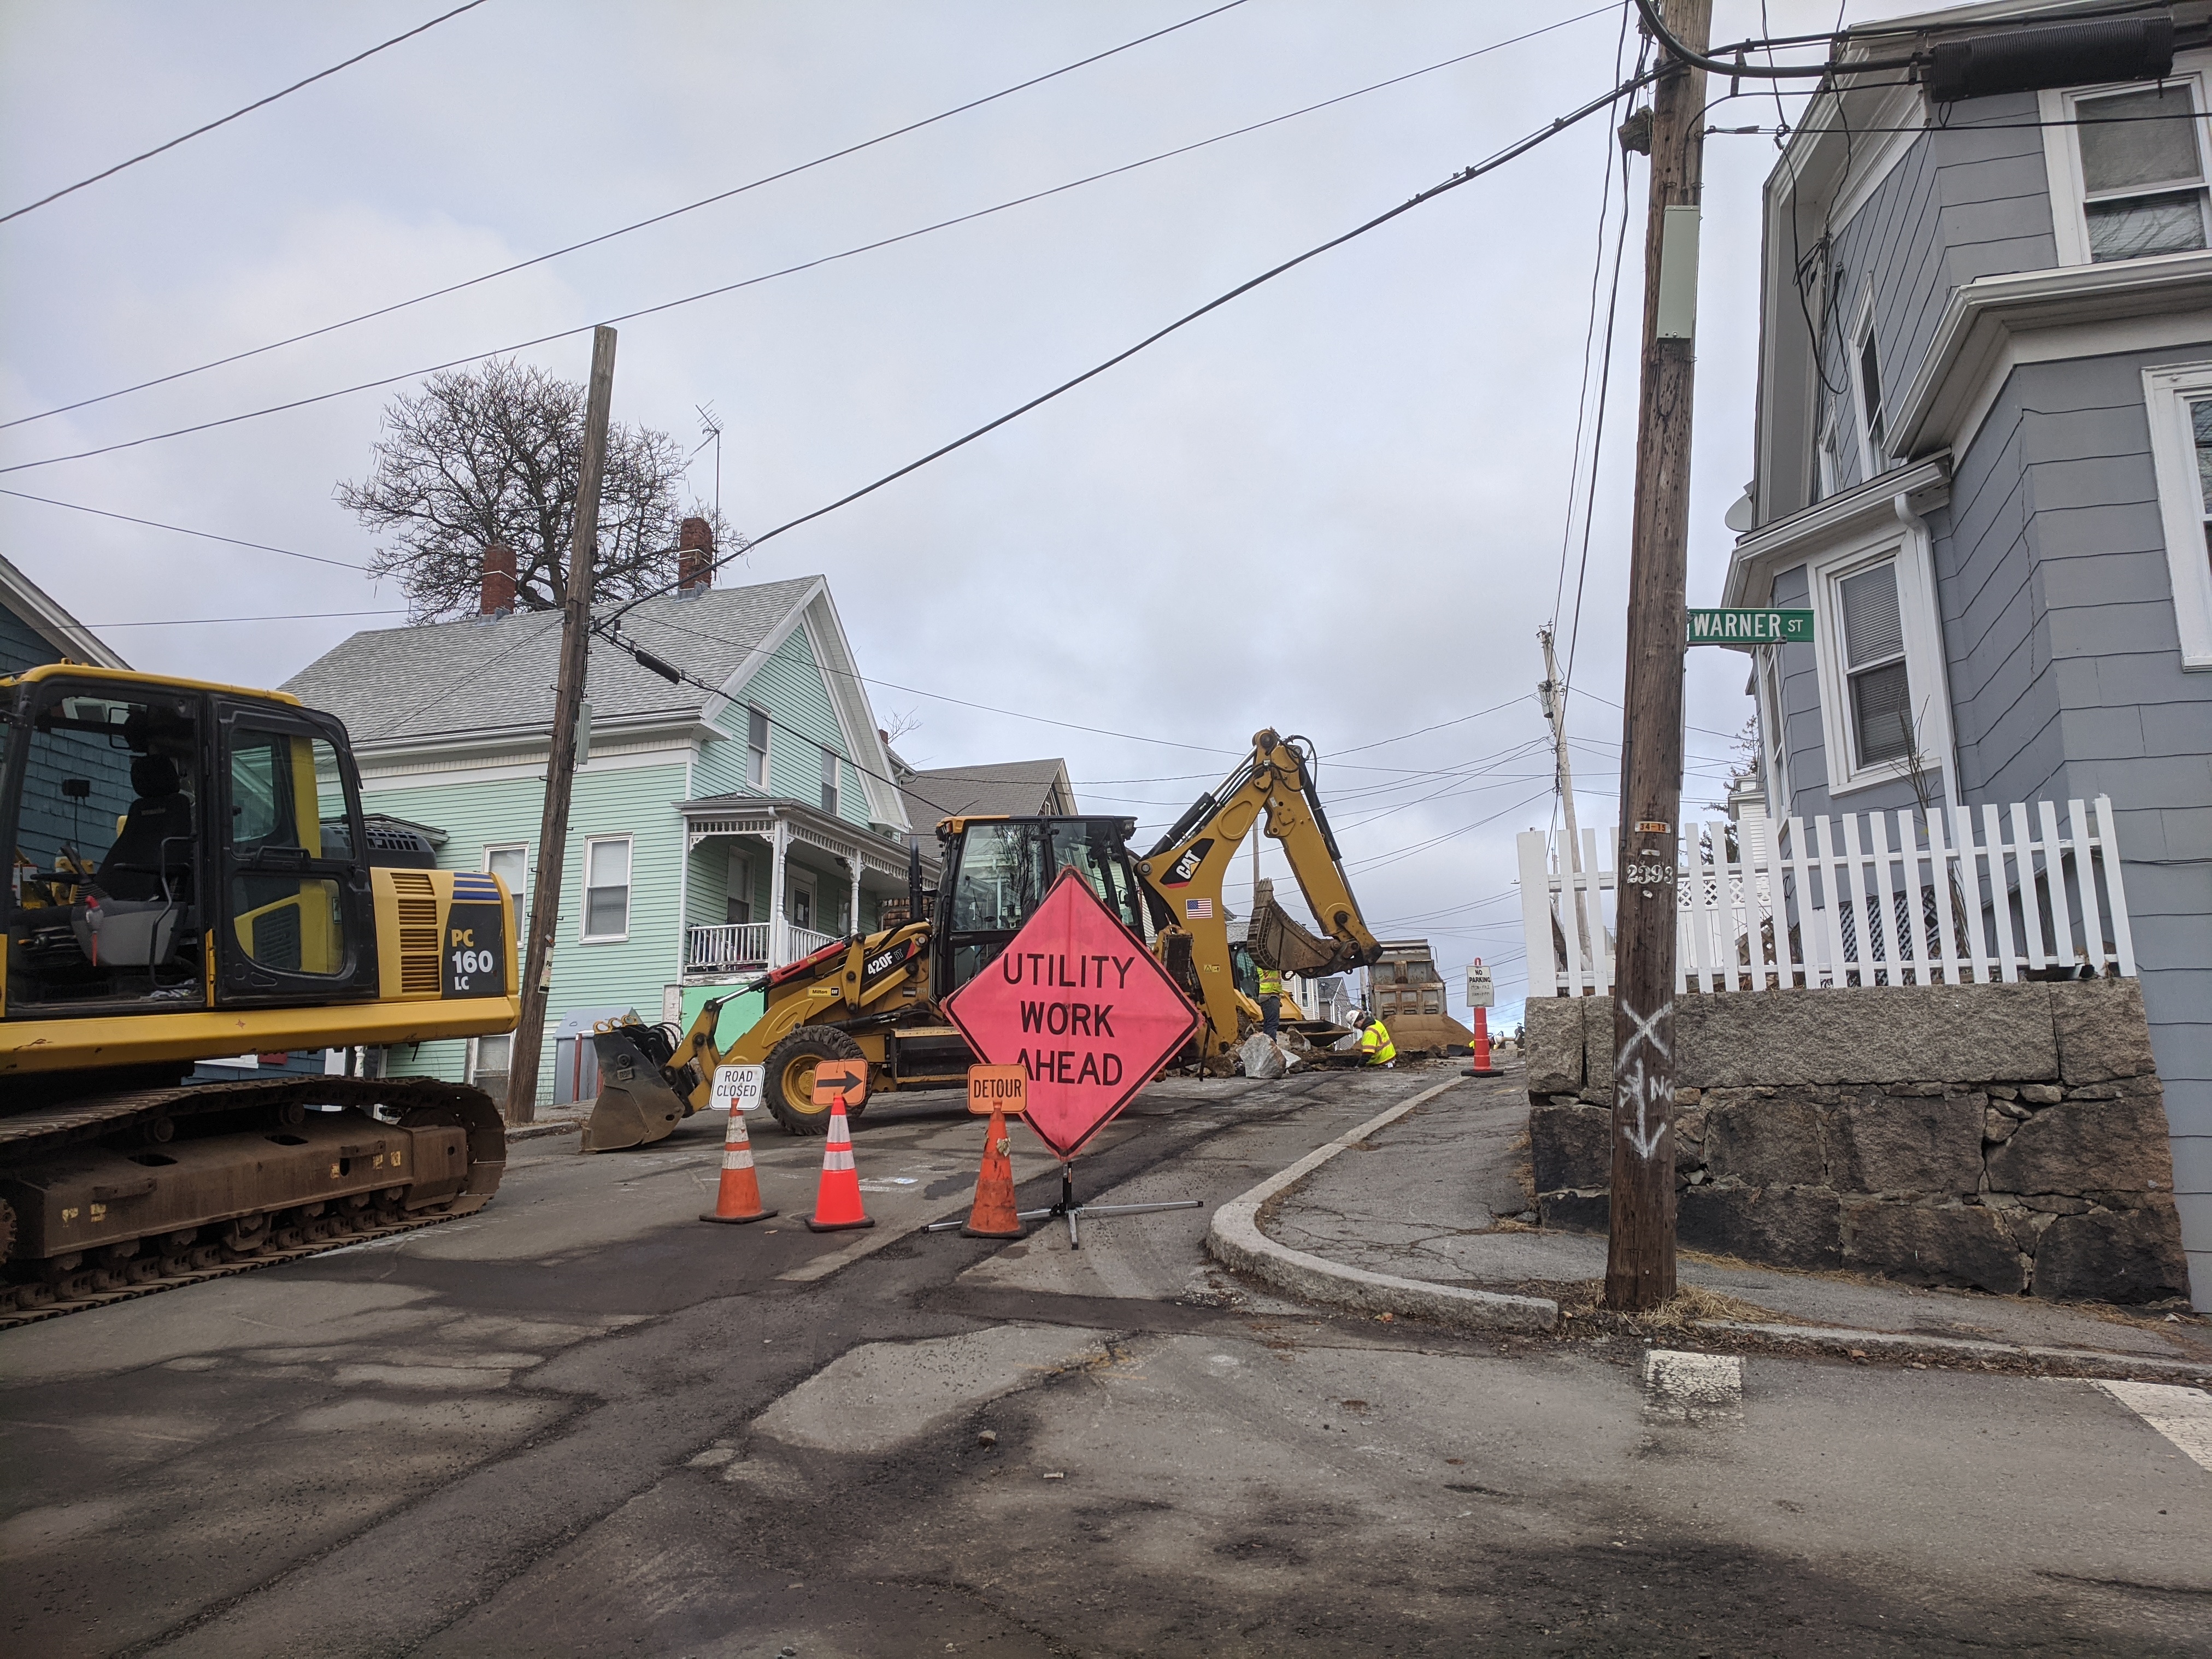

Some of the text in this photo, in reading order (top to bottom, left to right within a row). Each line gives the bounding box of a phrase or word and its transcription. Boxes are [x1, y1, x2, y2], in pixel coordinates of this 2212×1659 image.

[1693, 613, 1803, 637] WARNER ST
[1176, 849, 1201, 879] CAT
[1627, 864, 1674, 885] 2393
[451, 929, 474, 947] PC
[452, 950, 493, 973] 160
[868, 952, 893, 975] 420F
[1003, 952, 1136, 989] UTILITY
[454, 976, 469, 990] LC
[1020, 1001, 1115, 1038] WORK
[724, 1070, 753, 1083] ROAD
[1017, 1048, 1123, 1086] AHEAD
[716, 1085, 757, 1097] CLOSED
[974, 1079, 1022, 1098] DETOUR
